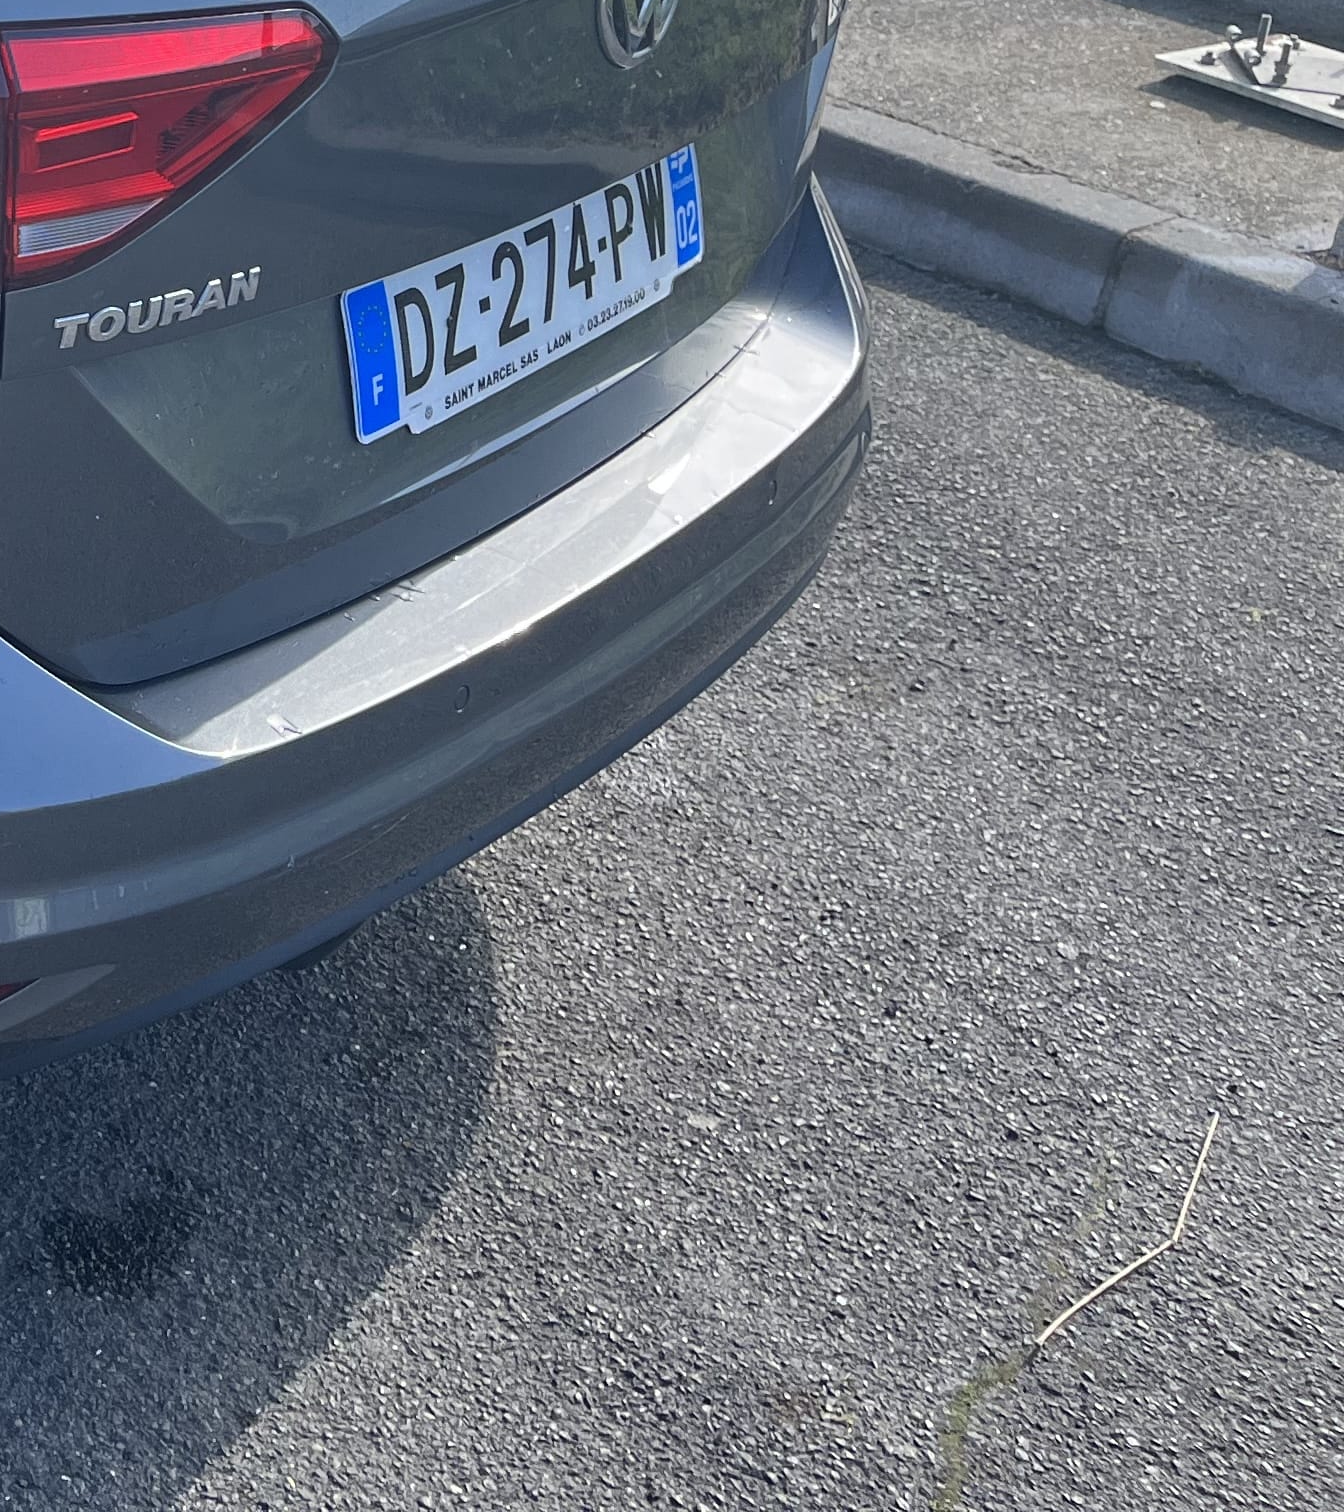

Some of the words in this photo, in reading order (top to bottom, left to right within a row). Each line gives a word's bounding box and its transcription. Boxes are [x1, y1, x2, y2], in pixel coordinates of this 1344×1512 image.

[676, 199, 698, 249] 02
[54, 267, 262, 349] TOURAN
[372, 373, 385, 406] F
[444, 384, 474, 410] SAINT
[478, 360, 518, 393] MARCEL
[520, 349, 539, 369] SAS
[547, 329, 572, 354] LAON
